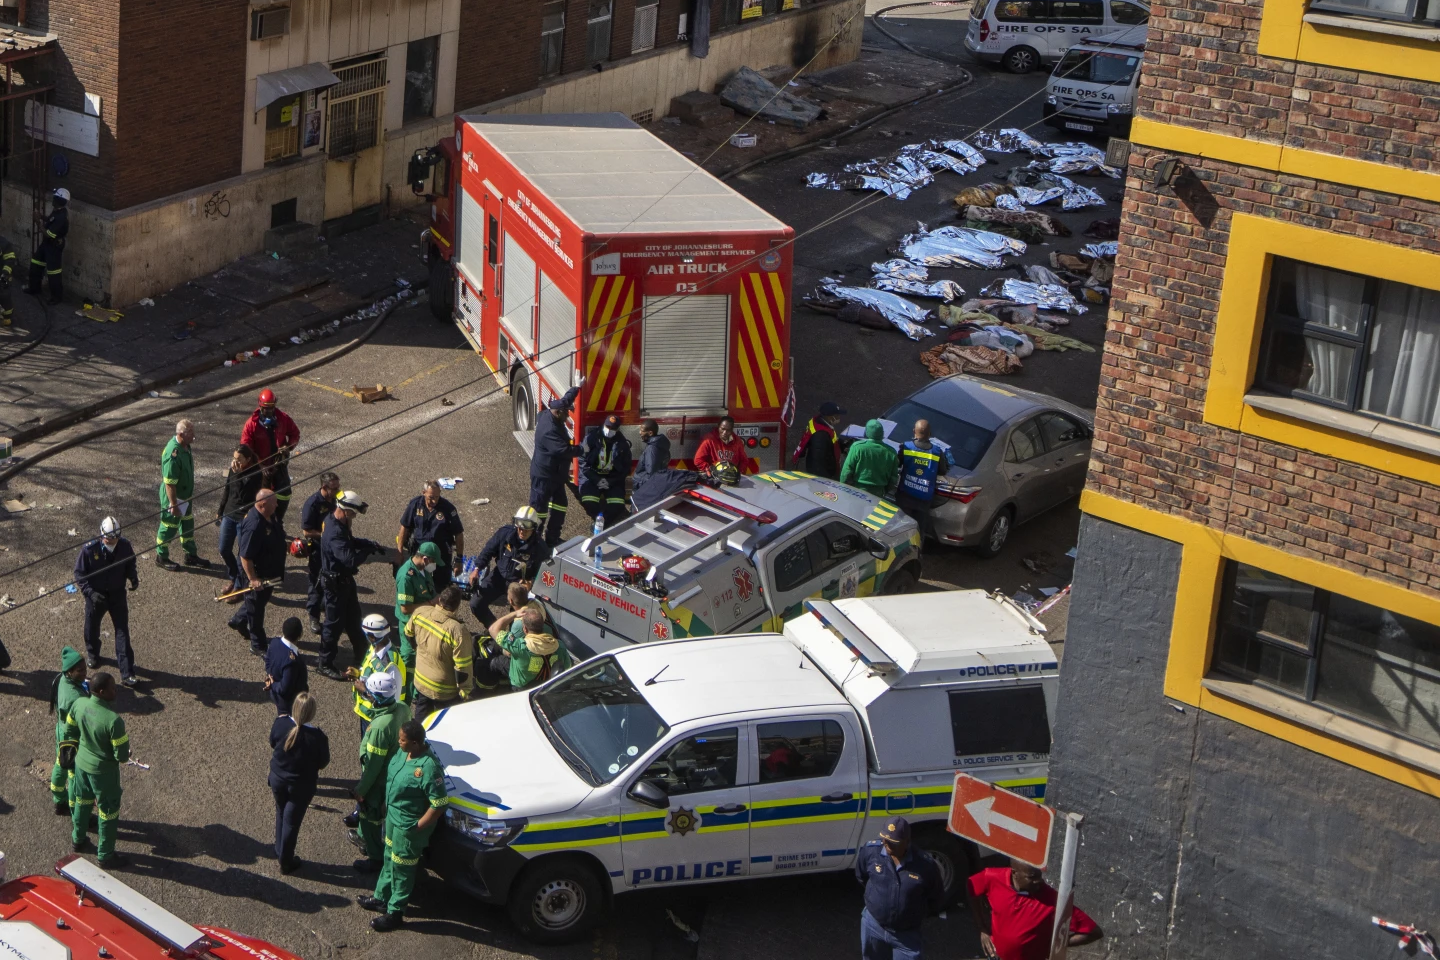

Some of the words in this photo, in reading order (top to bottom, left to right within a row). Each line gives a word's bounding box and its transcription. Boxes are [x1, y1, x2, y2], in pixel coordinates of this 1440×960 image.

[996, 25, 1029, 33] FIRE
[1034, 25, 1066, 33] OPS
[1071, 26, 1091, 34] SA
[1052, 85, 1073, 95] FIRE
[1076, 88, 1097, 98] OPS
[1101, 92, 1115, 101] SA
[647, 264, 674, 275] AIR
[678, 262, 728, 274] TRUCK
[676, 282, 698, 293] 03
[914, 458, 929, 466] POLICE
[563, 573, 607, 602] RESPONSE
[609, 593, 647, 619] VEHICLE
[720, 589, 733, 604] 112
[967, 664, 1016, 678] POLICE
[964, 757, 986, 765] POLICE
[987, 755, 1014, 763] SERVICE
[631, 860, 743, 885] POLICE
